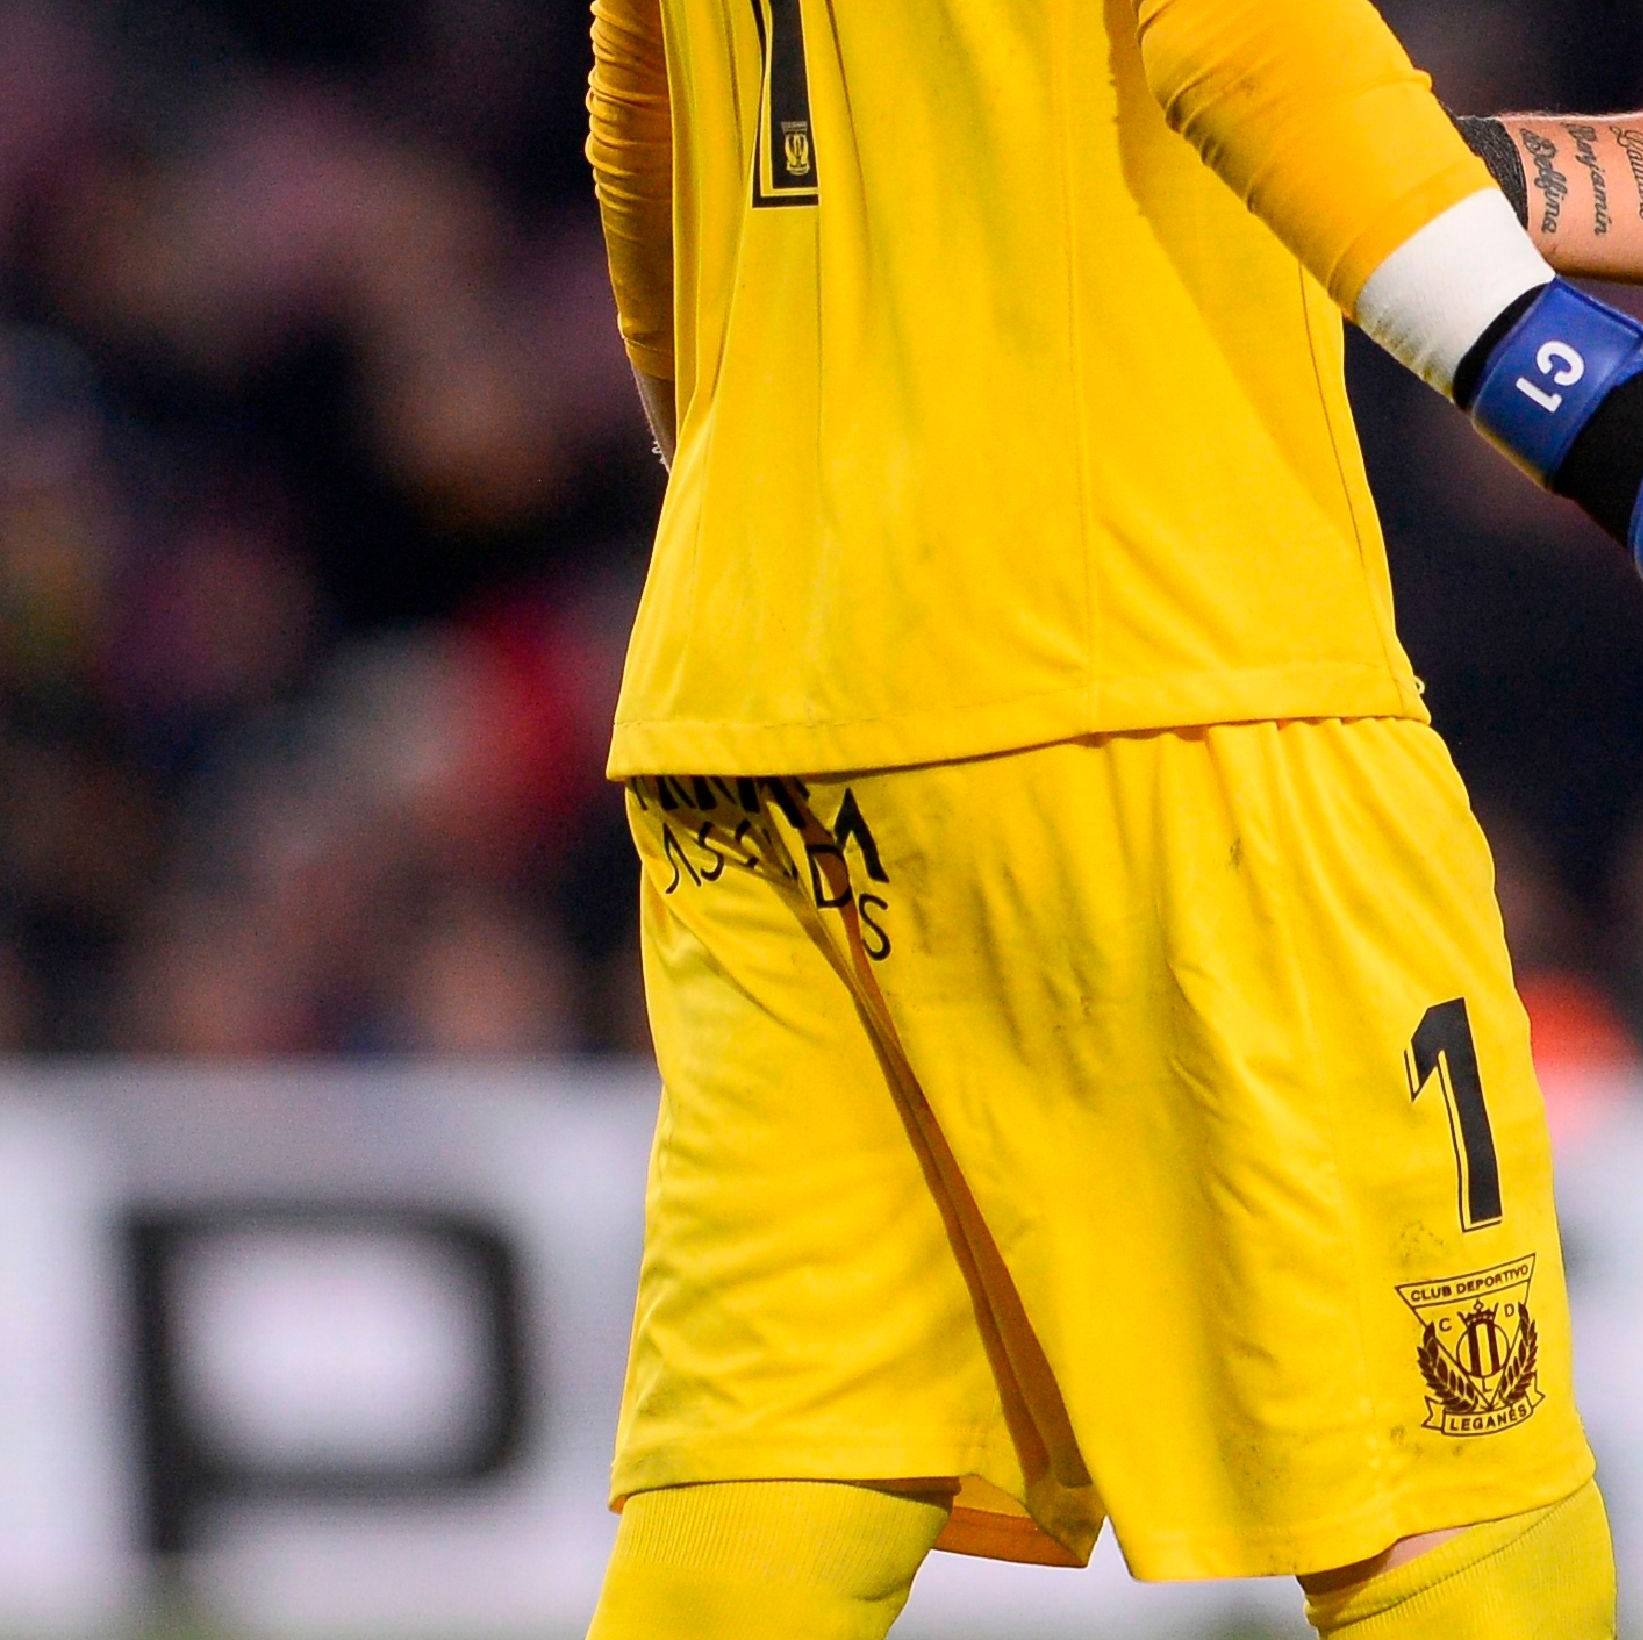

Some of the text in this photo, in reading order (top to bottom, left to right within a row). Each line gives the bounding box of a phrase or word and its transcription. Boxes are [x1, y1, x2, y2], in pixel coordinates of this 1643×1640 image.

[1516, 340, 1585, 415] C1
[1404, 997, 1503, 1232] 1
[1410, 1264, 1529, 1303] CLUB DEPORTIVO
[1438, 1303, 1515, 1332] C D
